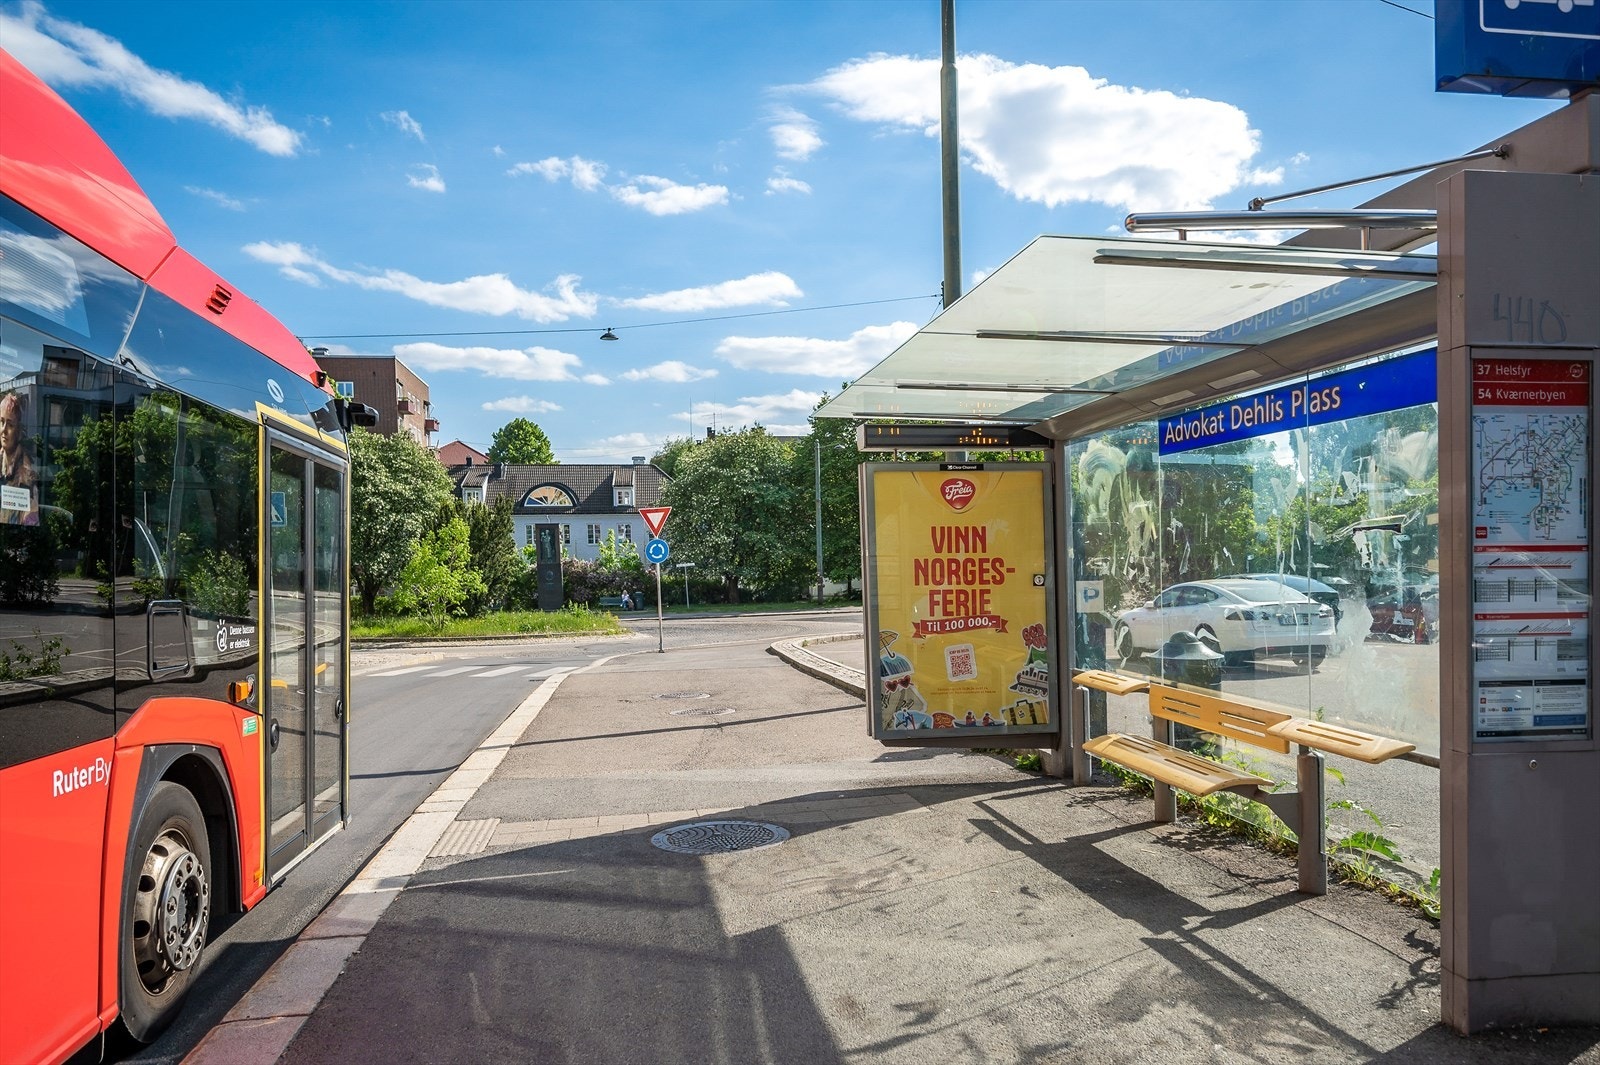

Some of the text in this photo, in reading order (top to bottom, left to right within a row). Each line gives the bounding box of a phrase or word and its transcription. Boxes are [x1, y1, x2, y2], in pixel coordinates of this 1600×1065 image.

[1477, 364, 1532, 378] 37 Helsfyr
[1478, 388, 1566, 402] 54 Kværnerbyen
[1164, 386, 1341, 445] Advokat Dehlis Plass
[945, 480, 973, 500] Freia
[930, 526, 987, 554] VINN
[913, 557, 1015, 586] NORGES-
[928, 589, 992, 617] FERIE
[926, 616, 997, 632] Til 100 000,-
[52, 757, 112, 798] RuterBy
